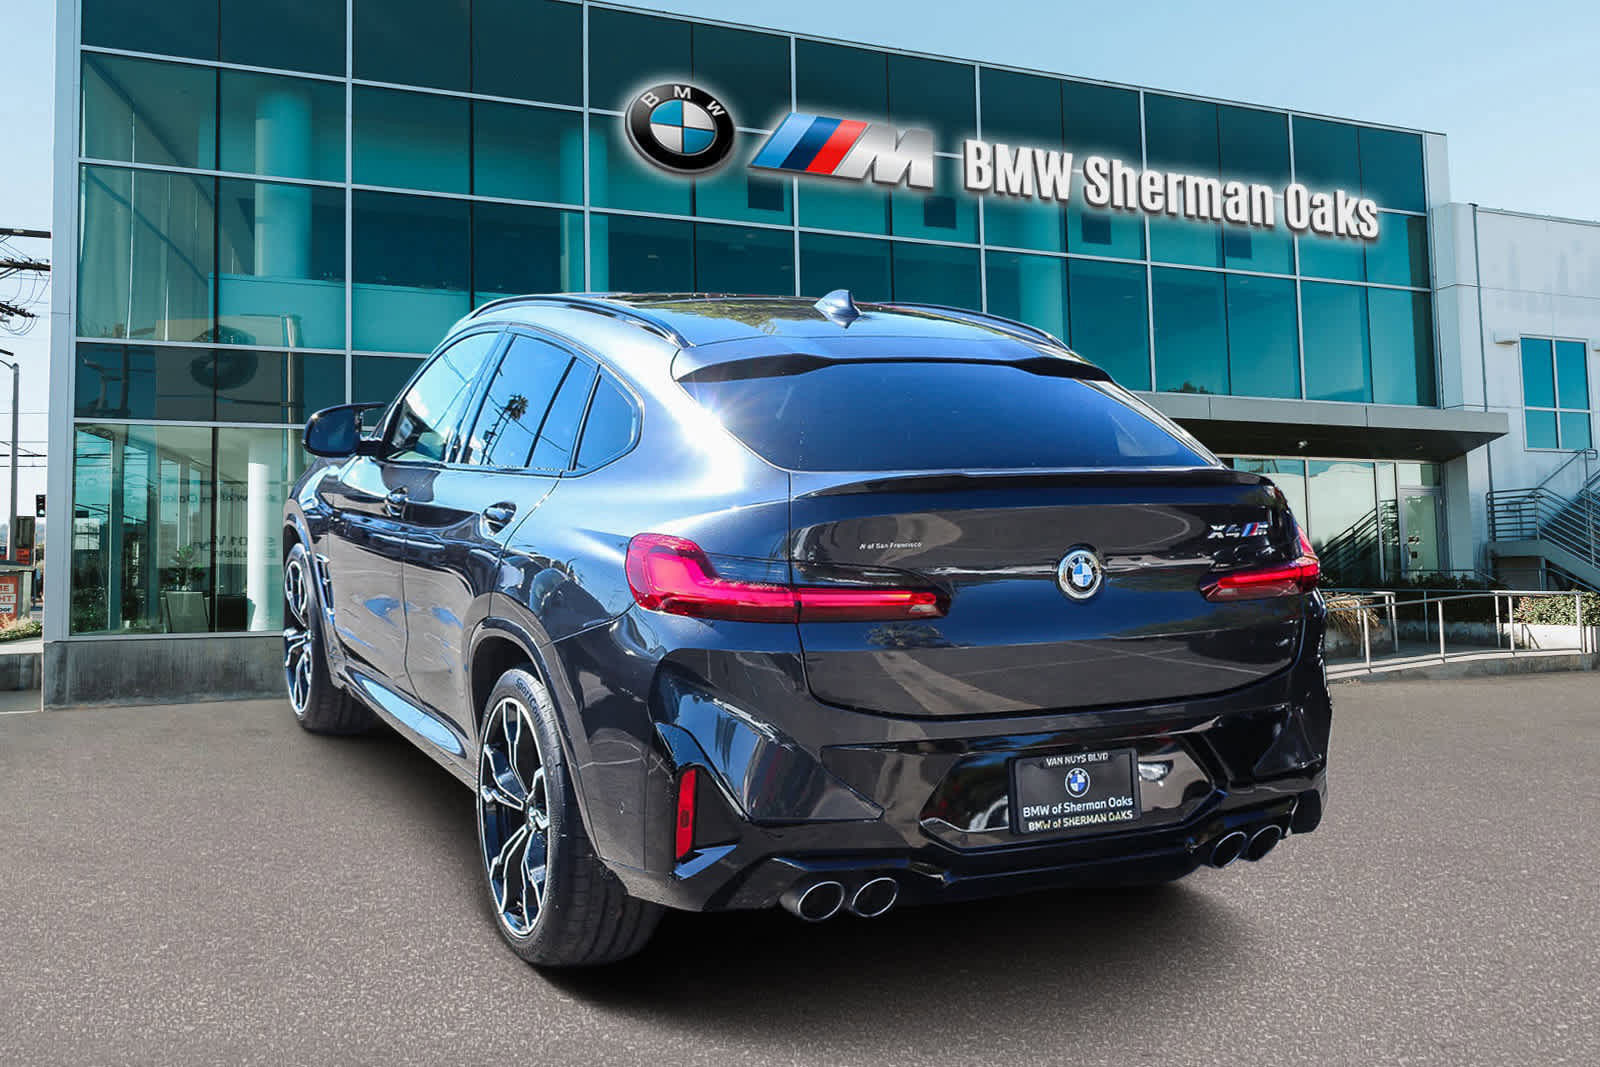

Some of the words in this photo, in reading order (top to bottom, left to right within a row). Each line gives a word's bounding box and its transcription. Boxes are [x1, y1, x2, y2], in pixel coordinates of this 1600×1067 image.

[641, 85, 726, 118] BMW
[832, 122, 934, 188] M
[963, 139, 1073, 200] BMW
[1083, 156, 1275, 226] Sherman
[1284, 183, 1379, 240] Oaks
[1046, 756, 1064, 766] VAN
[1064, 754, 1087, 765] NUYS
[1088, 752, 1108, 762] BLVD
[1023, 805, 1050, 817] BMW
[1052, 803, 1063, 814] of
[1064, 799, 1107, 813] Sherman
[1108, 796, 1133, 808] Oaks
[1028, 820, 1051, 832] BMW
[1053, 819, 1062, 829] of
[1063, 813, 1107, 827] SHERMAN
[1108, 810, 1133, 821] OAKS
